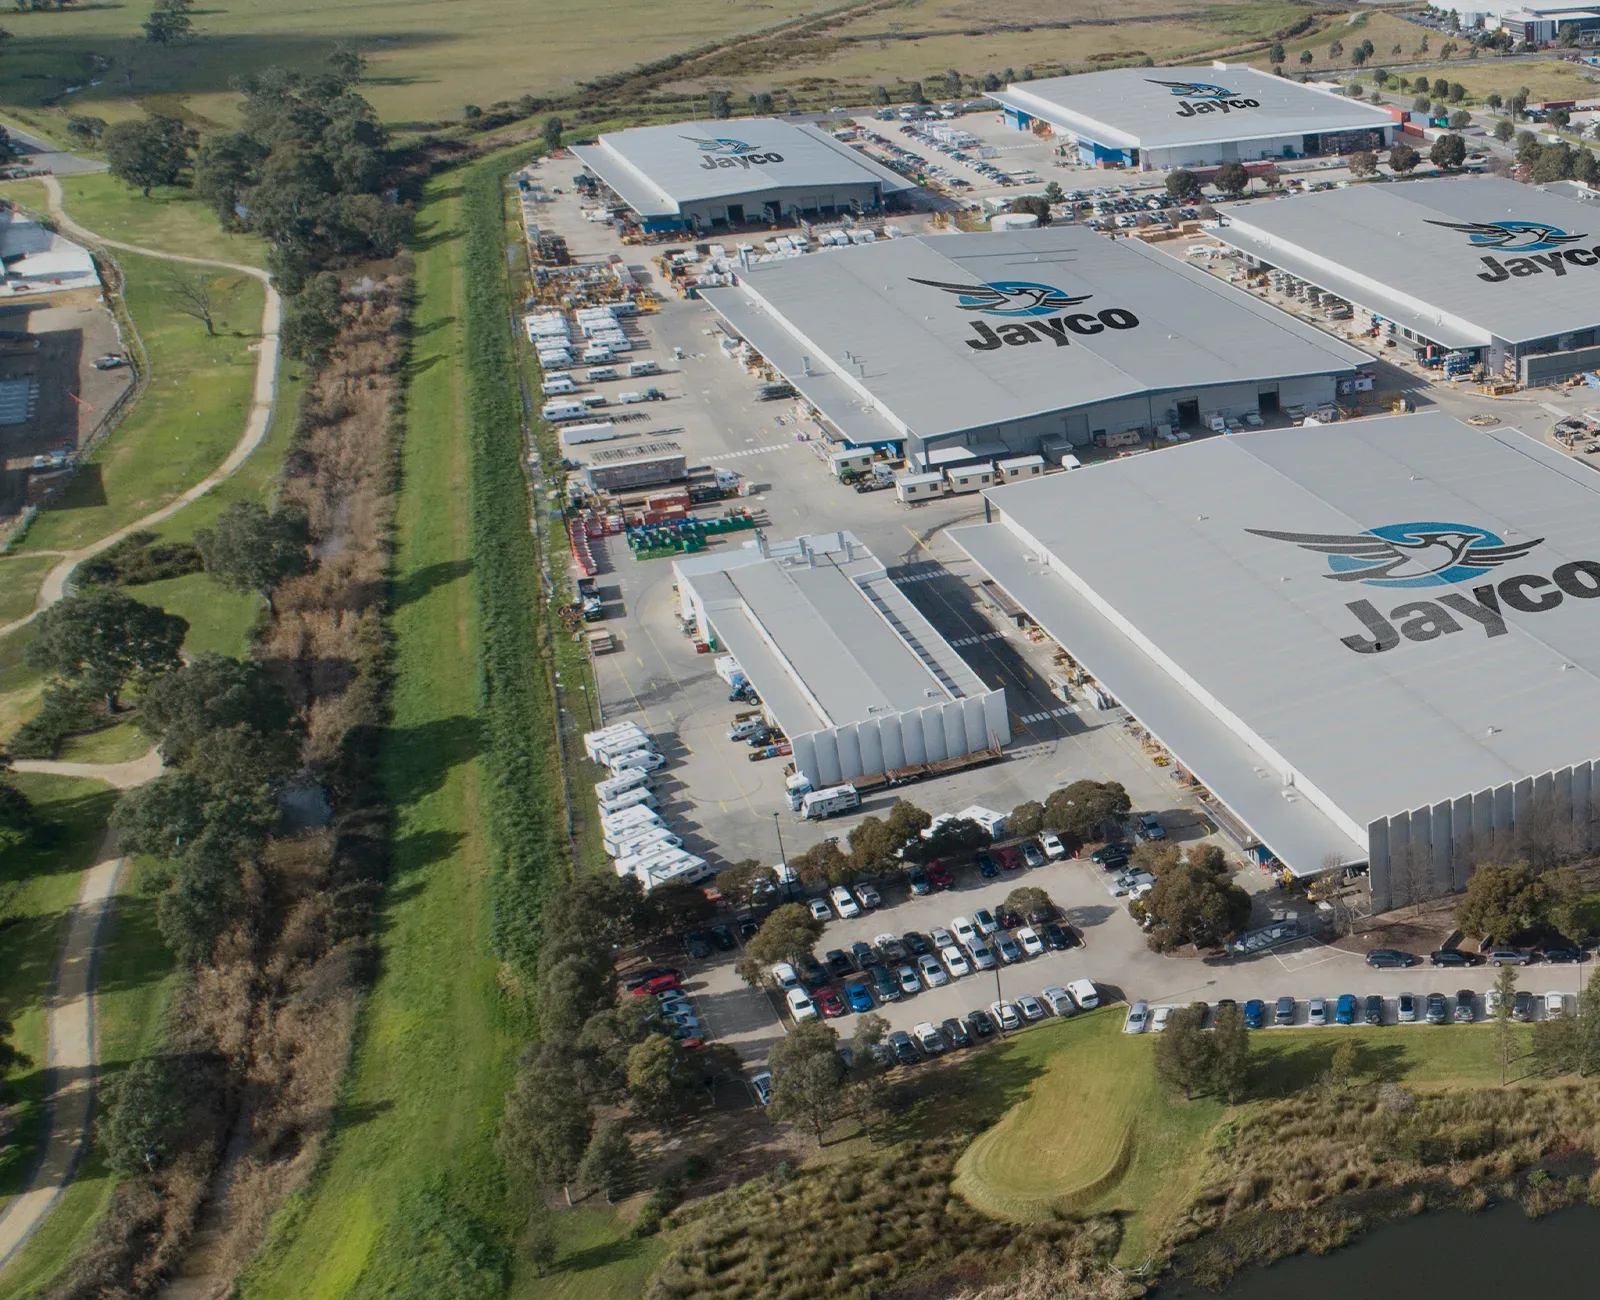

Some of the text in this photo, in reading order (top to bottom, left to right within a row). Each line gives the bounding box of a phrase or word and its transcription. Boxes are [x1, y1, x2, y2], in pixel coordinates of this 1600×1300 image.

[1176, 98, 1260, 117] Jayco
[700, 153, 784, 170] Jayco
[965, 308, 1139, 350] Jayco
